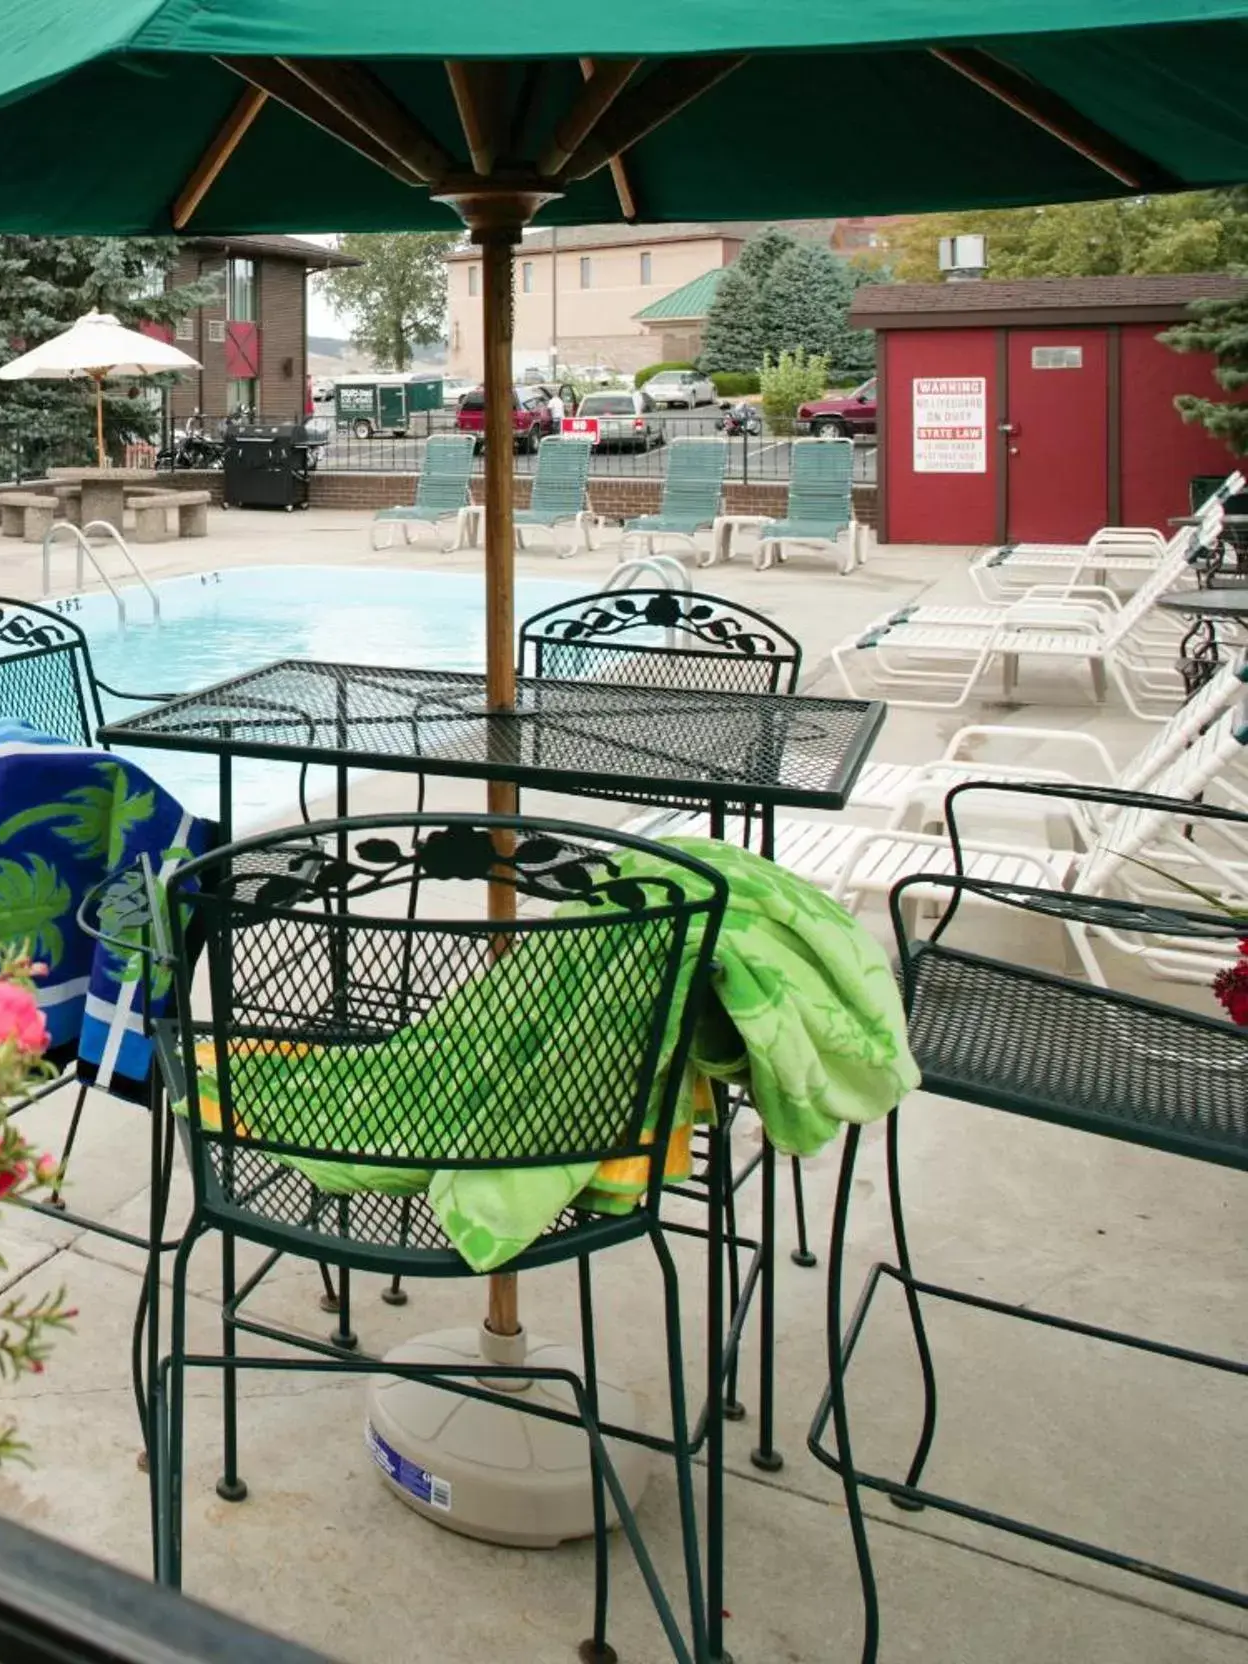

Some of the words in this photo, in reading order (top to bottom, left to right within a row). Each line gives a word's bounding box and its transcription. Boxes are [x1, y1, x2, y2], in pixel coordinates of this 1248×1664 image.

[919, 381, 980, 393] WARNING
[572, 419, 587, 431] NO
[919, 428, 952, 438] STATE
[955, 428, 980, 438] LAW
